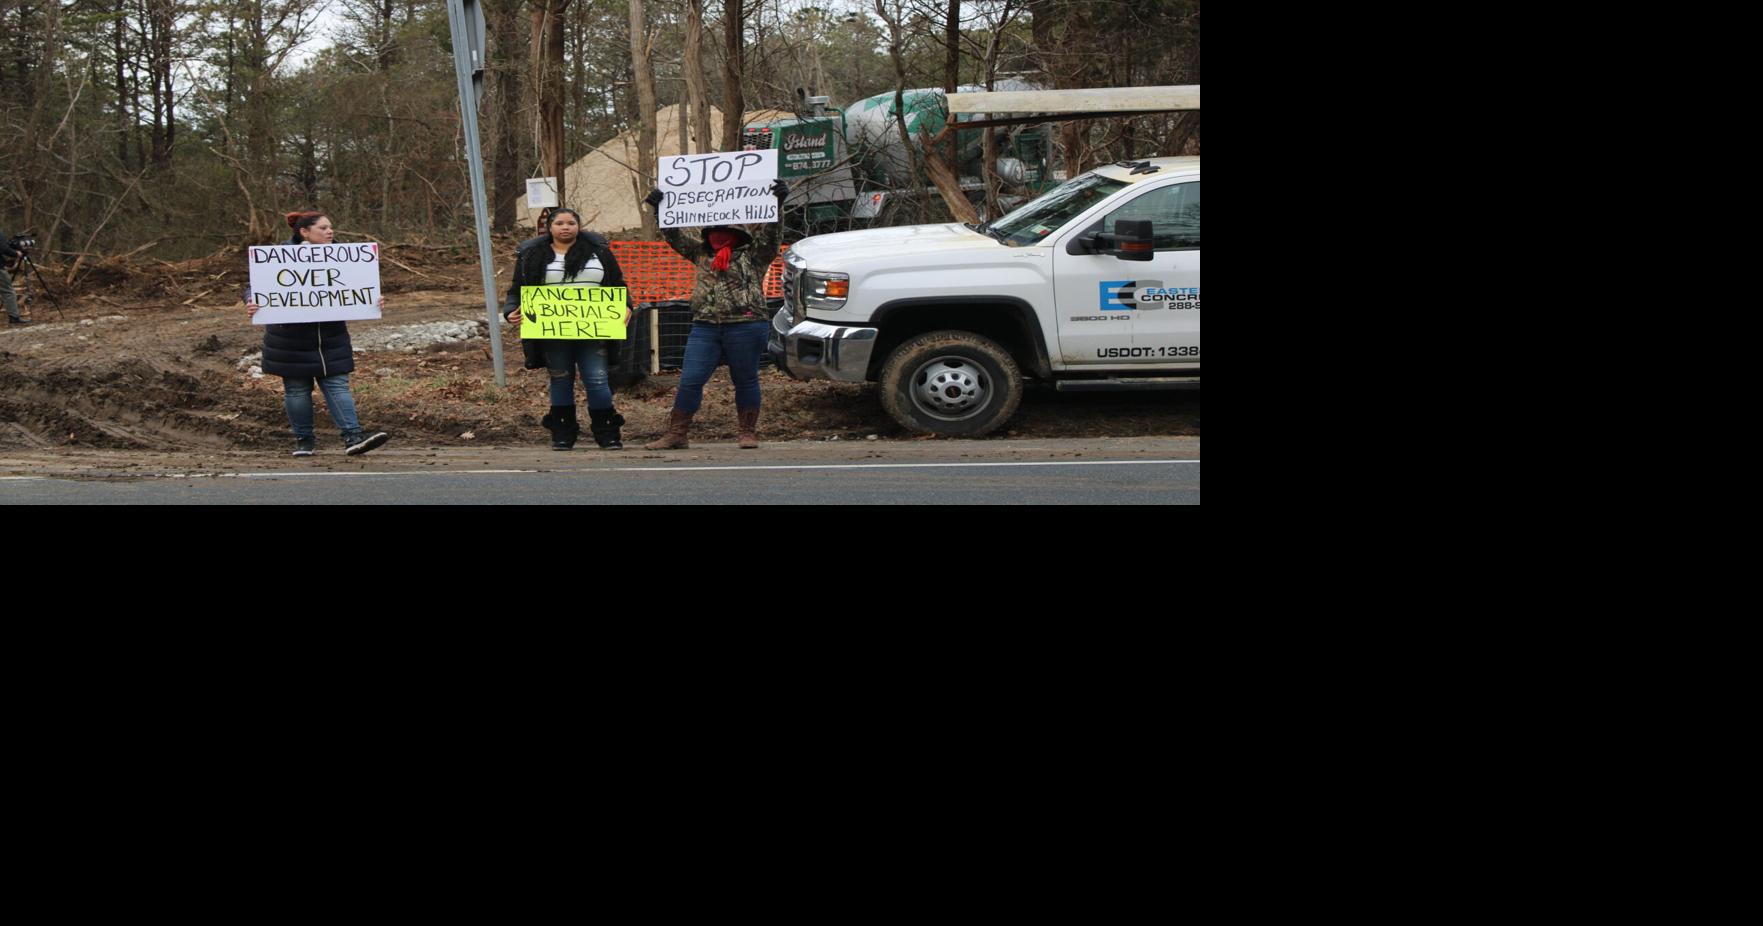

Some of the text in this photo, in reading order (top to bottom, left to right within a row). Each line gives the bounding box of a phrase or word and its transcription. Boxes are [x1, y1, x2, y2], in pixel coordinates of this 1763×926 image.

[784, 133, 825, 150] Island
[665, 153, 762, 186] STOP
[666, 185, 772, 209] DESECRATION
[663, 209, 740, 225] SHINNECOCK
[277, 268, 346, 287] OVER
[254, 287, 375, 308] DEVELOPMENT
[531, 287, 626, 302] ANCIENT
[1141, 294, 1200, 302] CONCR
[539, 303, 621, 320] BURIALS
[542, 321, 611, 338] HERE
[1097, 347, 1155, 358] USDOT:
